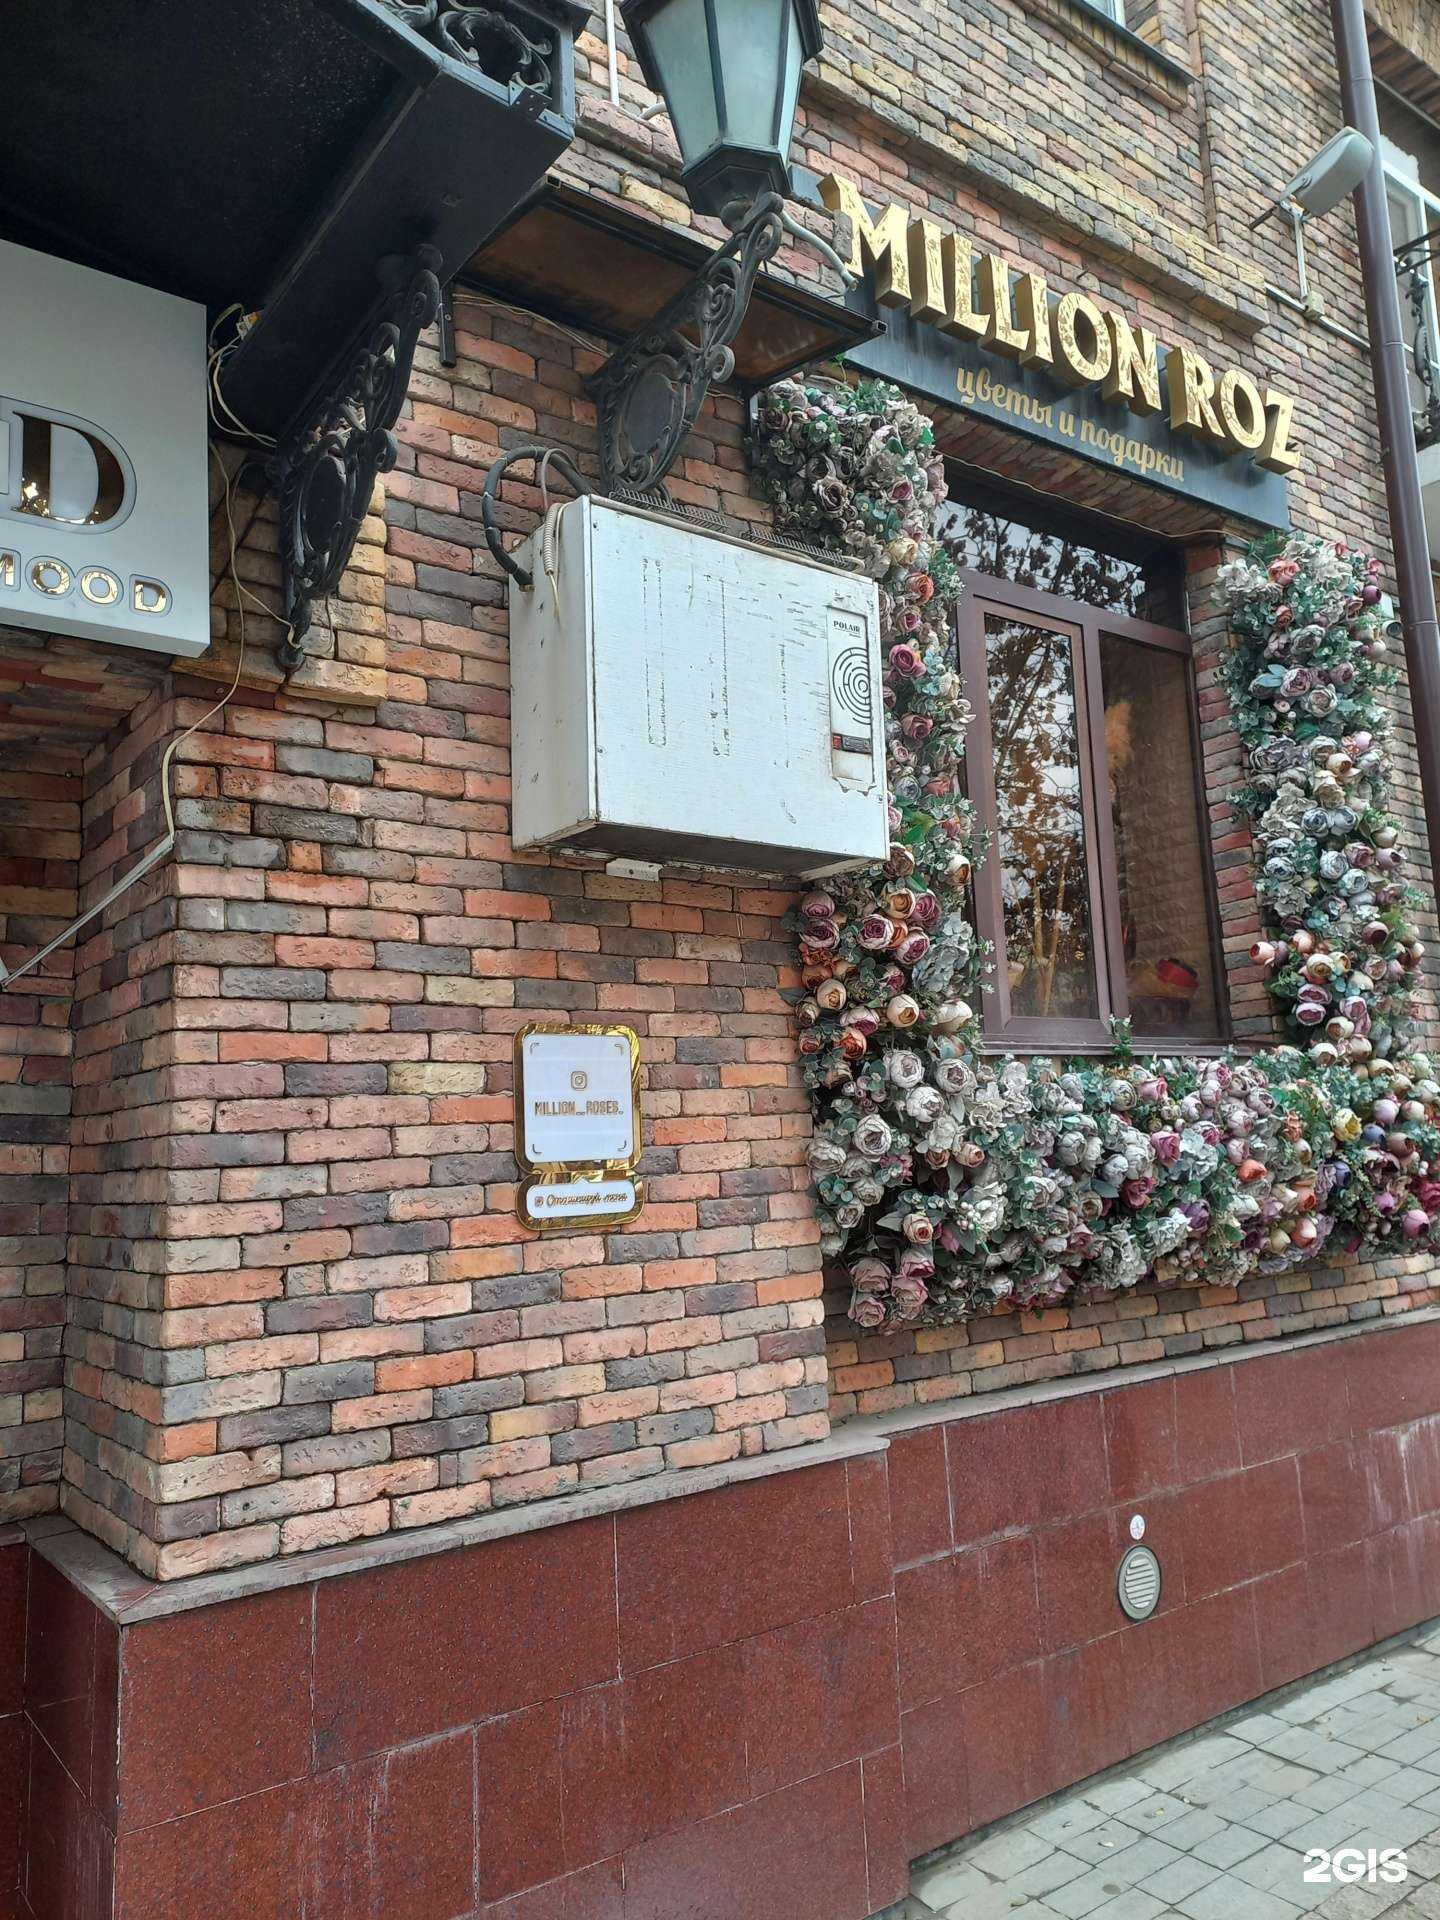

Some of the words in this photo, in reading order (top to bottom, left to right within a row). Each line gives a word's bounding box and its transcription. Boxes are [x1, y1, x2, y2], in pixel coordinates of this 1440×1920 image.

[816, 172, 1162, 417] MILLION
[1166, 345, 1301, 475] ROZ
[955, 367, 1054, 429] цветы
[1058, 410, 1076, 438] и
[1080, 417, 1185, 483] подарки
